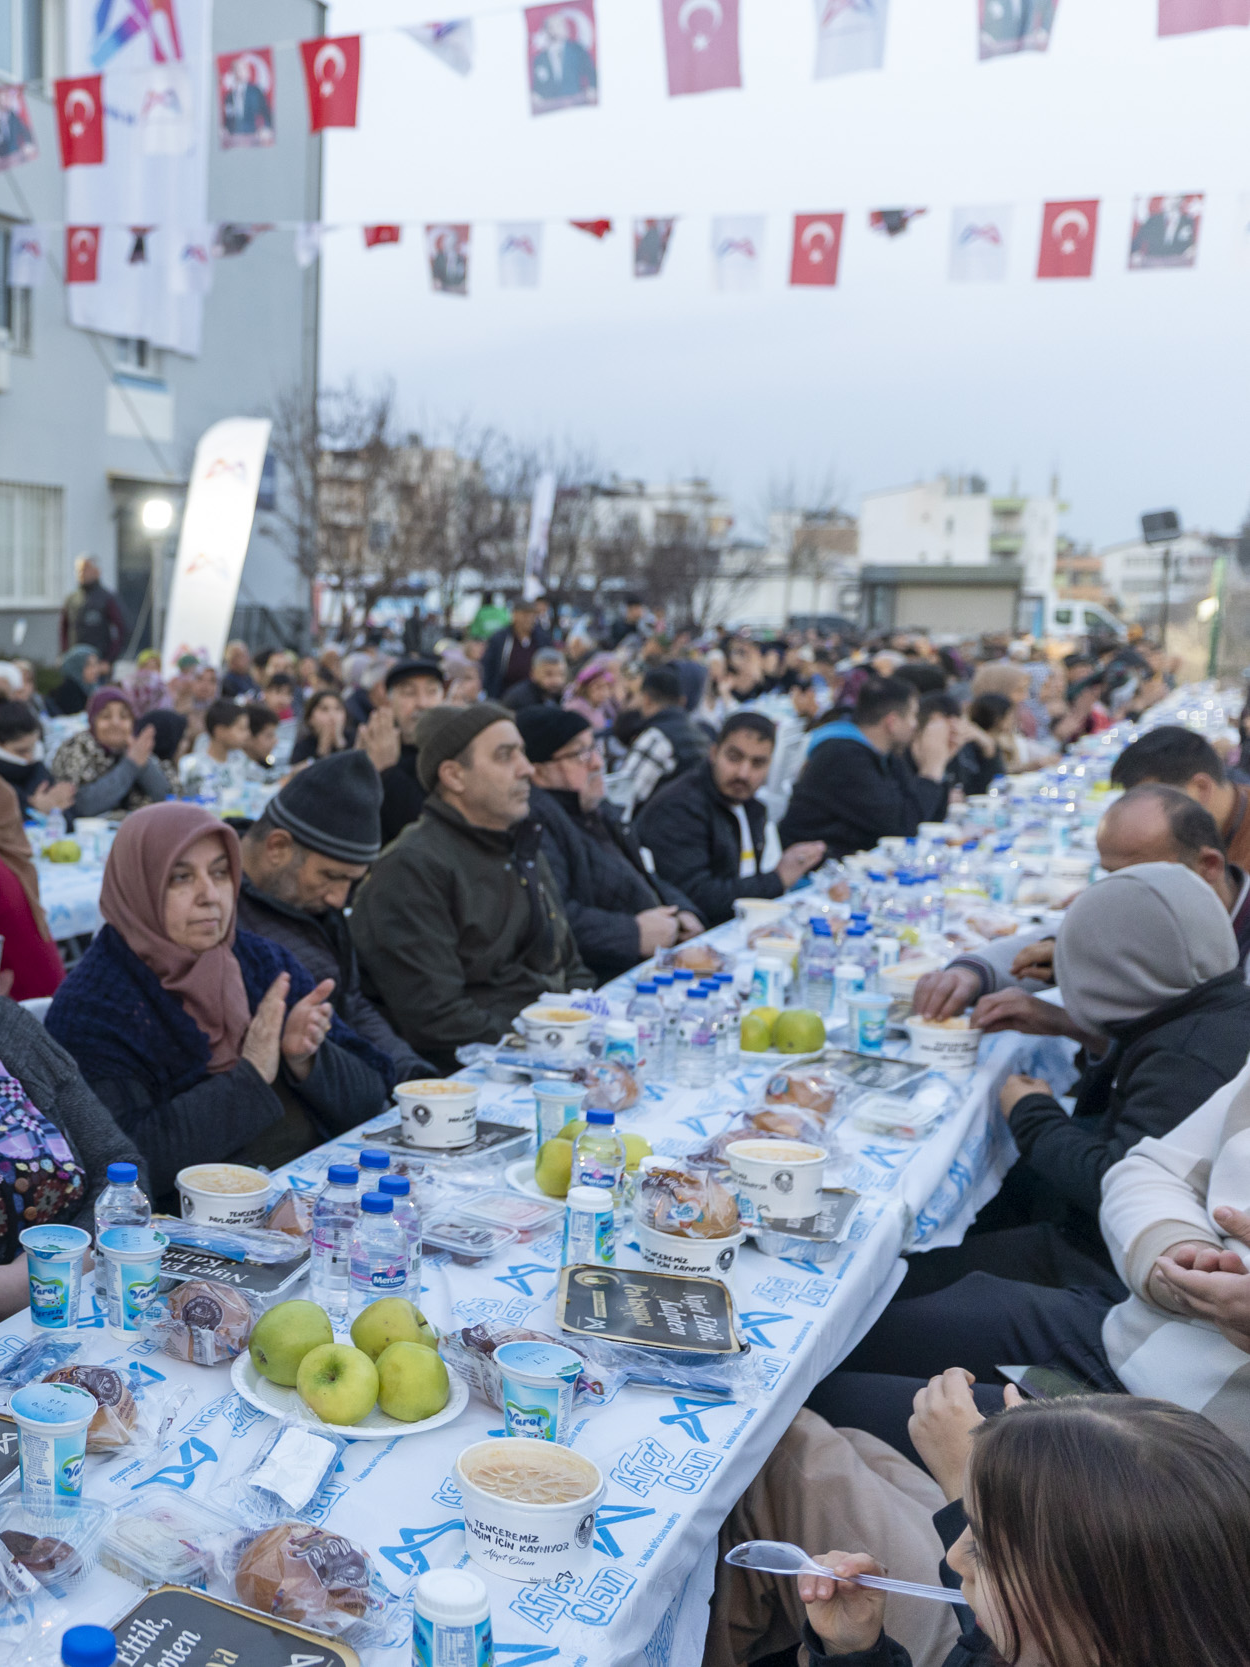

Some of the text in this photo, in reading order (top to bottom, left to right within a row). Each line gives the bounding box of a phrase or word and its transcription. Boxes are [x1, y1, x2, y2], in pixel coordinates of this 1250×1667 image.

[189, 1265, 249, 1283] Niyet
[507, 1408, 545, 1427] Varol
[617, 1441, 669, 1493] Afiyet
[664, 1451, 718, 1492] Olsun
[304, 1480, 343, 1524] lsun
[474, 1519, 540, 1543] TENCEREMİZ
[495, 1536, 515, 1550] İÇİN
[519, 1542, 570, 1554] KAYNIYOR
[482, 1548, 508, 1562] Afiyet
[508, 1555, 536, 1567] Olsun
[570, 1569, 629, 1622] Olsun
